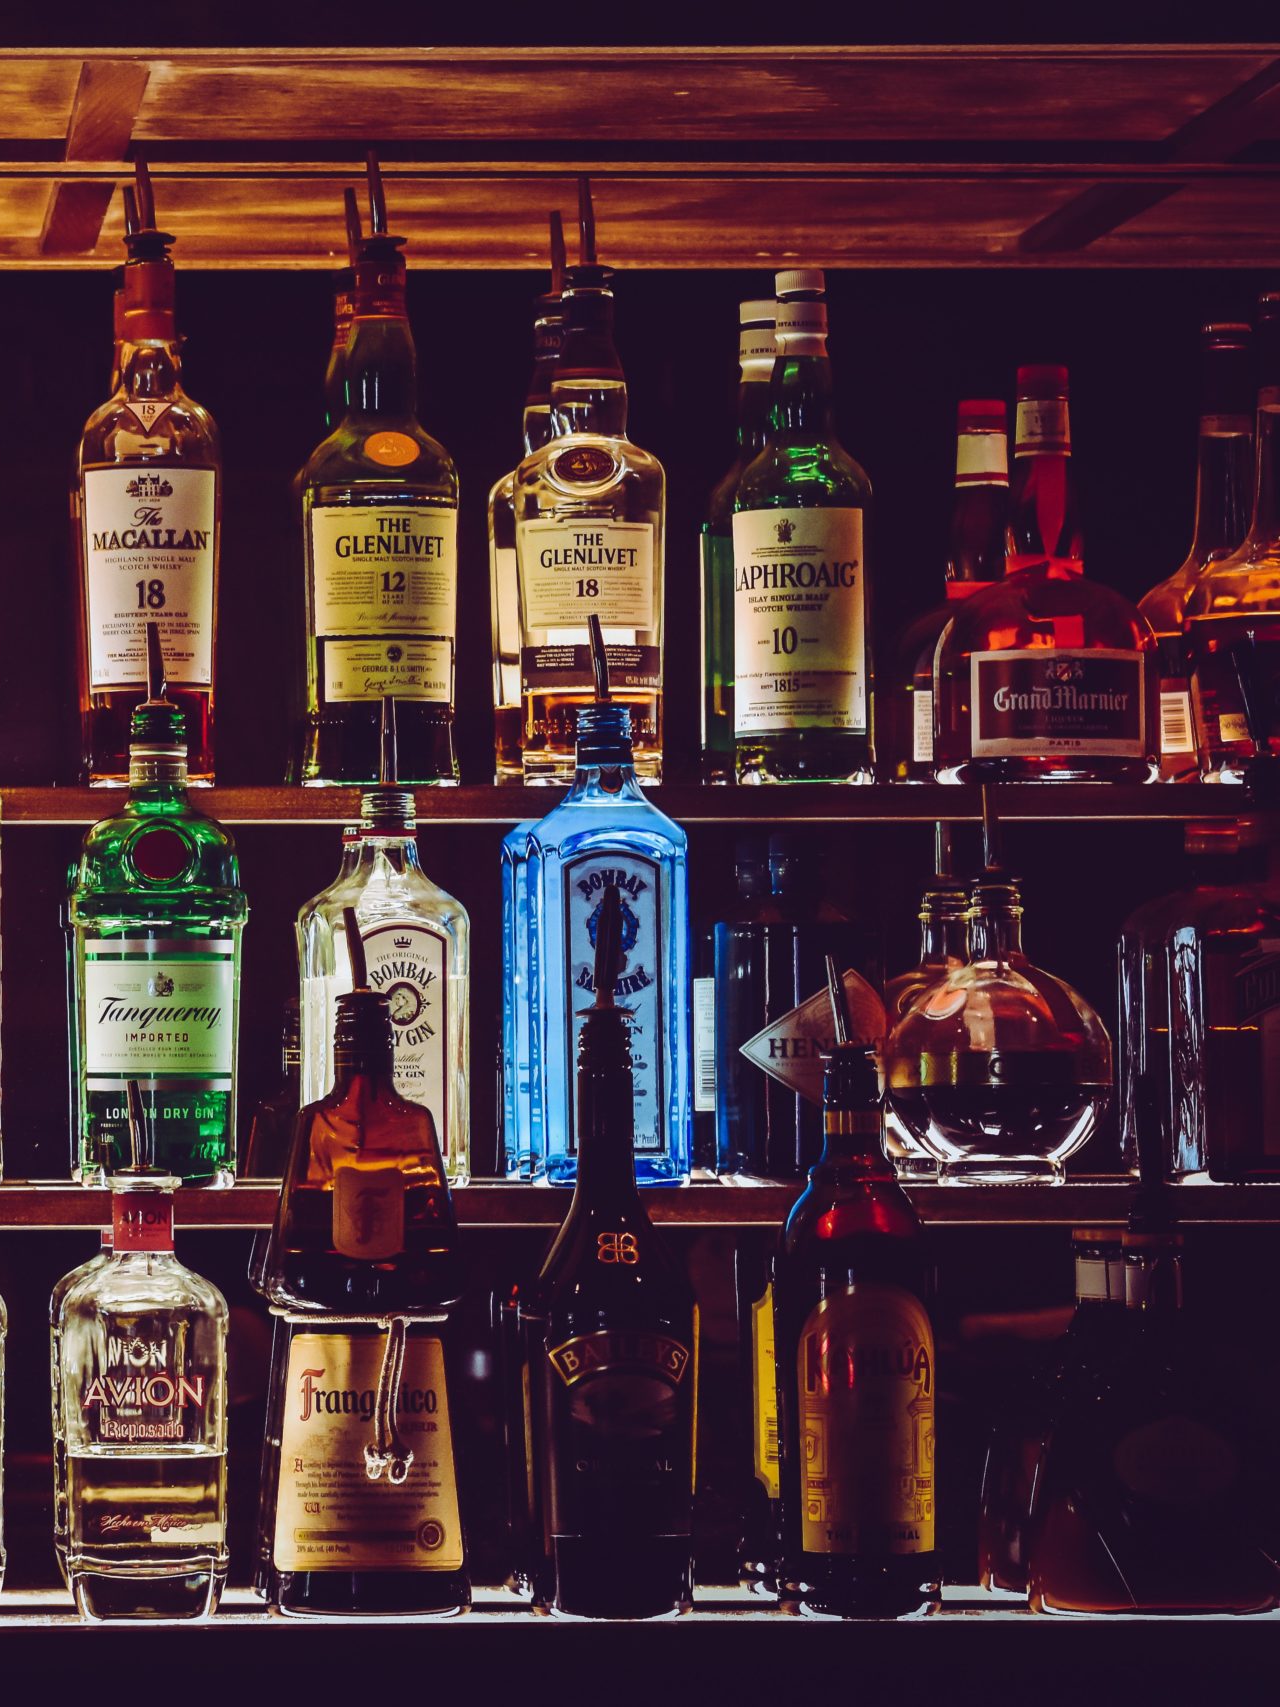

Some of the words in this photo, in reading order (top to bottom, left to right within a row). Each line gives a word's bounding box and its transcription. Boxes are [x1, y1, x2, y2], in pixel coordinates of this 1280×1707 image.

[142, 405, 156, 415] 18
[130, 507, 163, 527] The
[376, 518, 411, 533] THE
[93, 529, 210, 550] MACALLAN
[335, 534, 444, 558] GLENLIVET
[573, 533, 604, 546] THE
[540, 548, 638, 569] GLENLIVET
[381, 571, 405, 592] 12
[735, 560, 856, 592] LAPHROAIG
[136, 579, 166, 609] 18
[575, 579, 599, 597] 18
[773, 626, 798, 654] 10
[362, 665, 388, 673] GEORGE
[774, 679, 800, 692] 1815
[993, 686, 1051, 713] Grand
[1052, 685, 1129, 711] Marnier
[577, 869, 648, 900] BOMBAY
[376, 953, 391, 963] THE
[392, 951, 429, 963] ORIGINAL
[370, 961, 437, 990] BOMBAY
[98, 997, 222, 1029] Tanqueray
[126, 1033, 189, 1042] IMPORTED
[406, 1020, 436, 1047] GIN
[106, 1107, 157, 1119] LONON
[163, 1107, 189, 1119] DRY
[194, 1107, 215, 1119] GIN
[560, 1338, 686, 1373] BAILEYS
[84, 1371, 204, 1410] AVIÓN
[103, 1419, 184, 1441] Reposado
